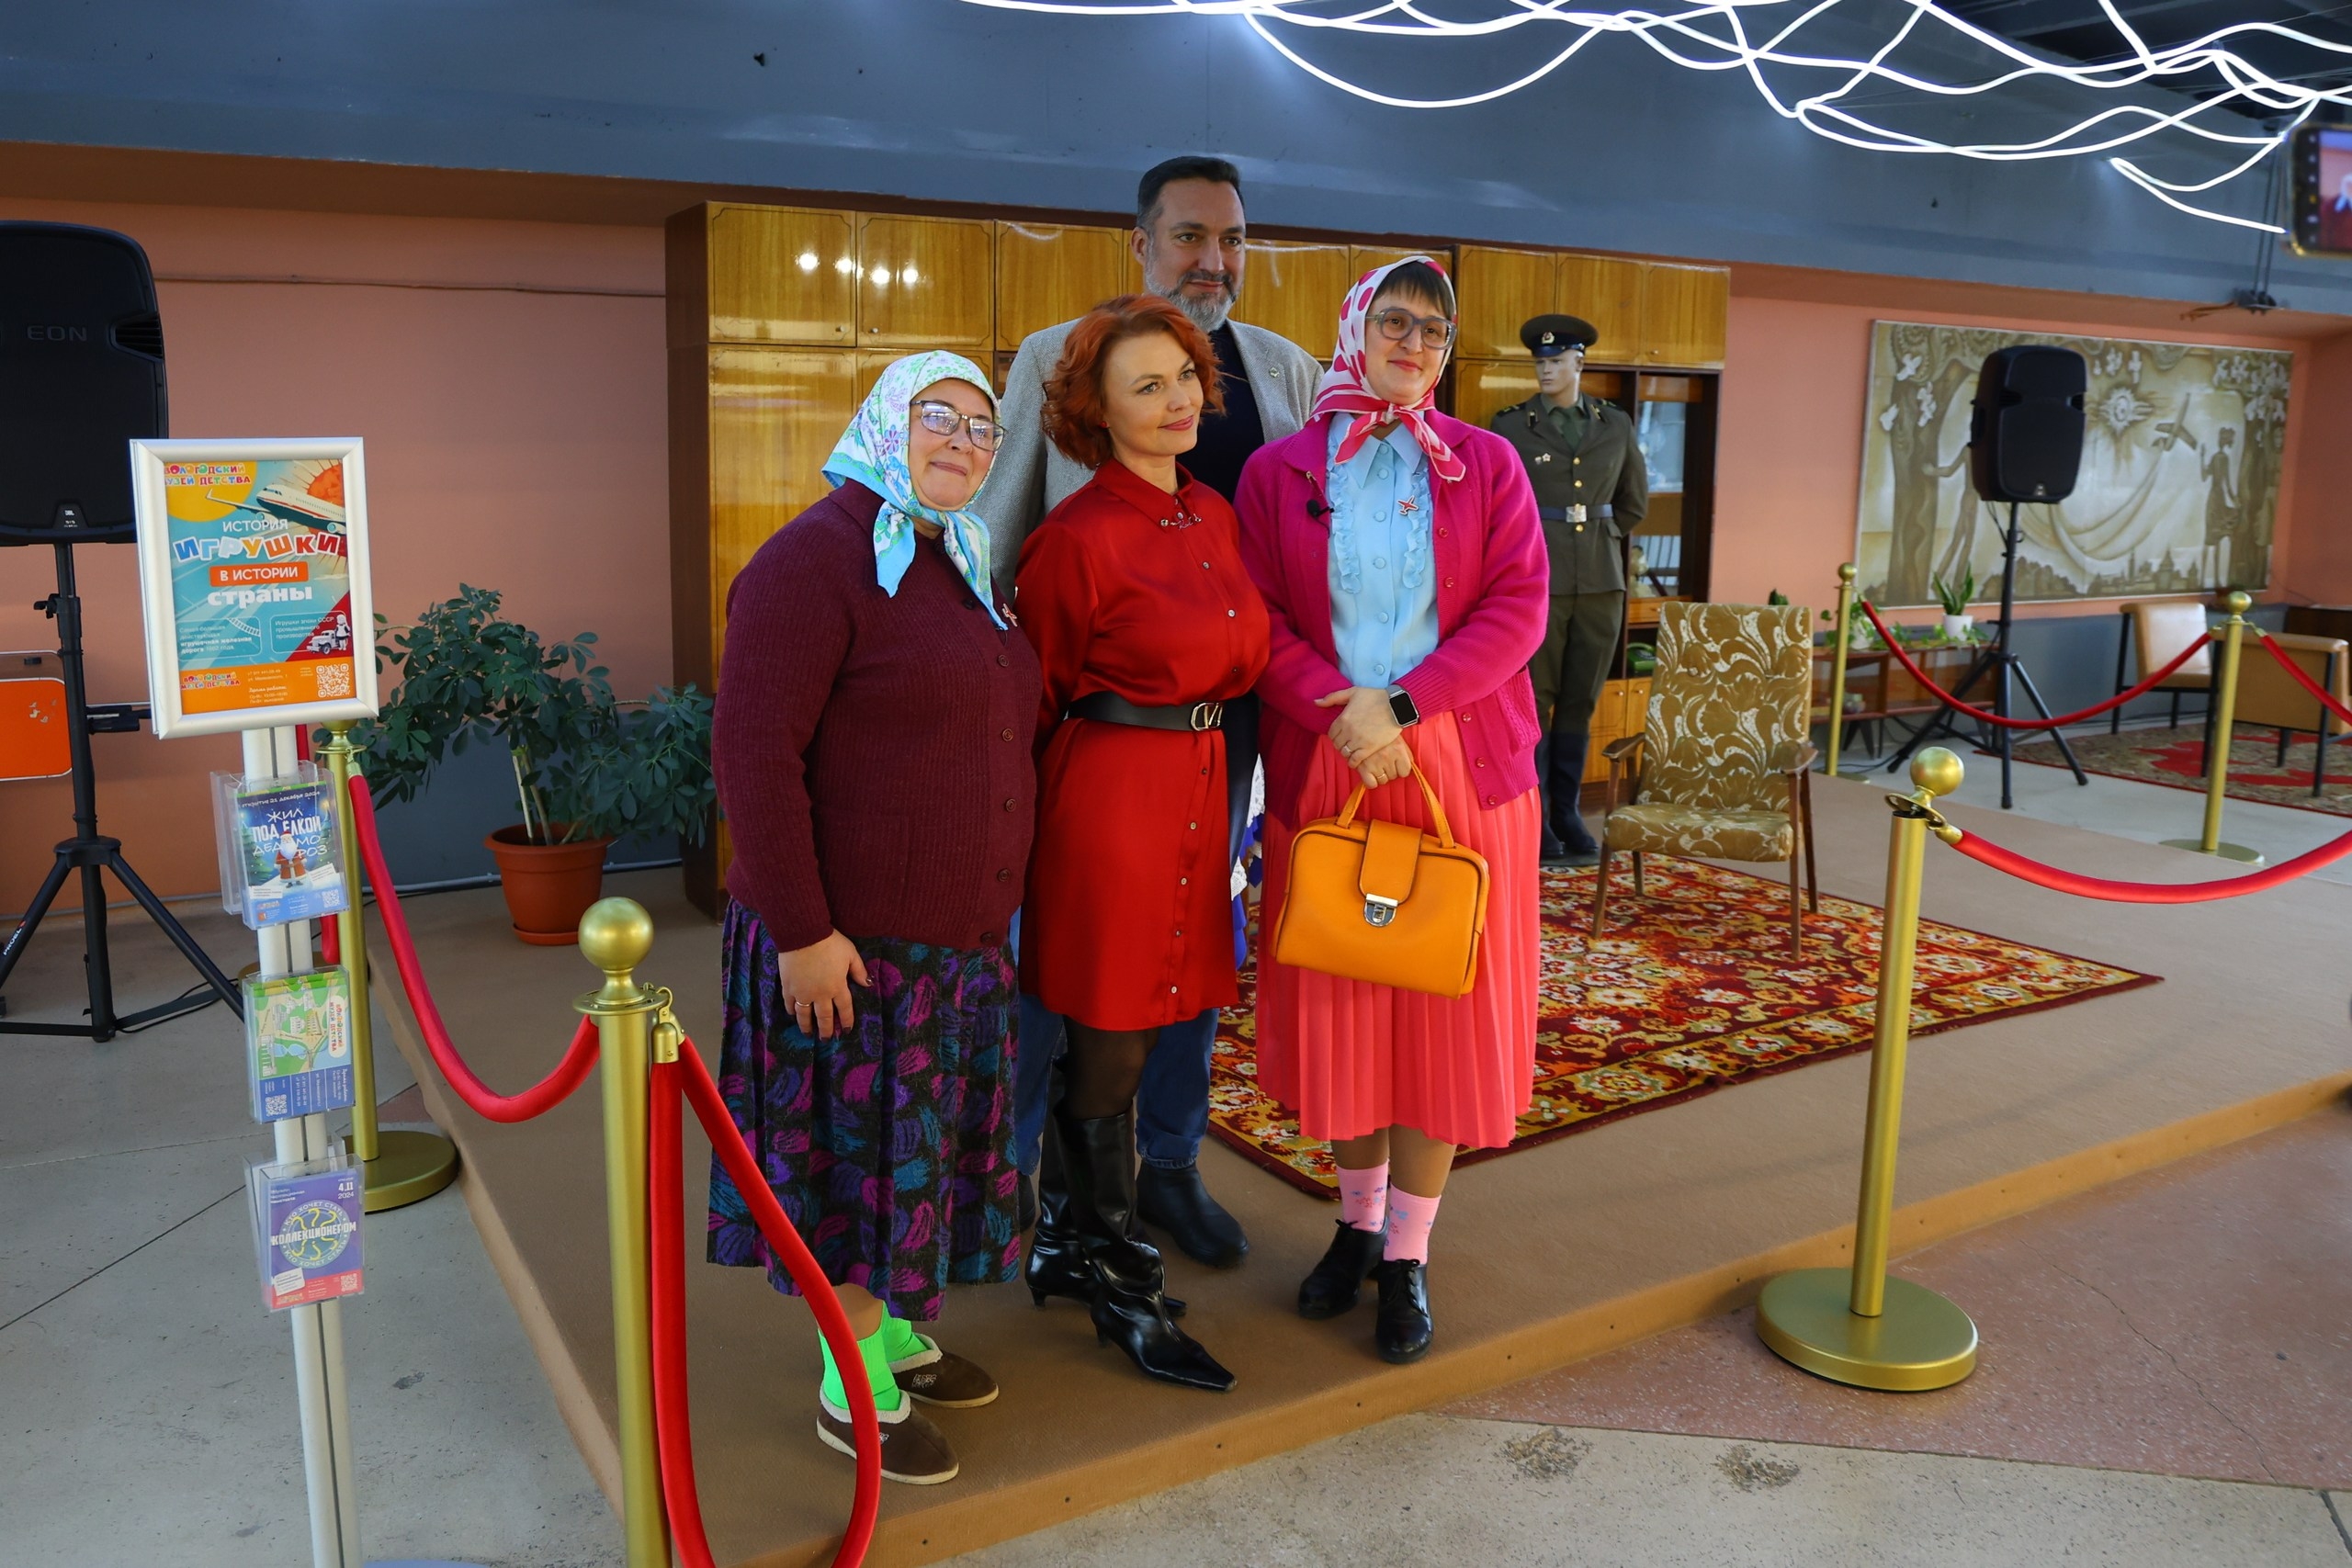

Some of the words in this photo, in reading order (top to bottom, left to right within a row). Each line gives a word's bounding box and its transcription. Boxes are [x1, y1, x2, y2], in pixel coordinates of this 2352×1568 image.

[27, 324, 88, 342] EON
[164, 475, 195, 486] УЗЕЙ
[199, 474, 252, 486] ДЕТСТВА
[222, 518, 288, 533] ИСТОРИЯ
[174, 533, 340, 561] ИГРУШКИ
[220, 570, 229, 581] В
[232, 566, 299, 581] ИСТОРИИ
[207, 586, 313, 609] страны
[266, 808, 303, 823] ЖИЛ
[252, 823, 279, 842] ПОД
[253, 841, 281, 856] ДЕД
[296, 845, 328, 859] РОЗ
[337, 1191, 355, 1200] 2024
[284, 1212, 297, 1225] КТО
[299, 1201, 323, 1211] ХОЧЕТ
[324, 1202, 343, 1216] СТАТЬ
[271, 1222, 356, 1246] КОЛЛЕКЦИОНЕРОМ
[284, 1249, 298, 1263] КТО
[327, 1239, 346, 1260] СТАТЬ
